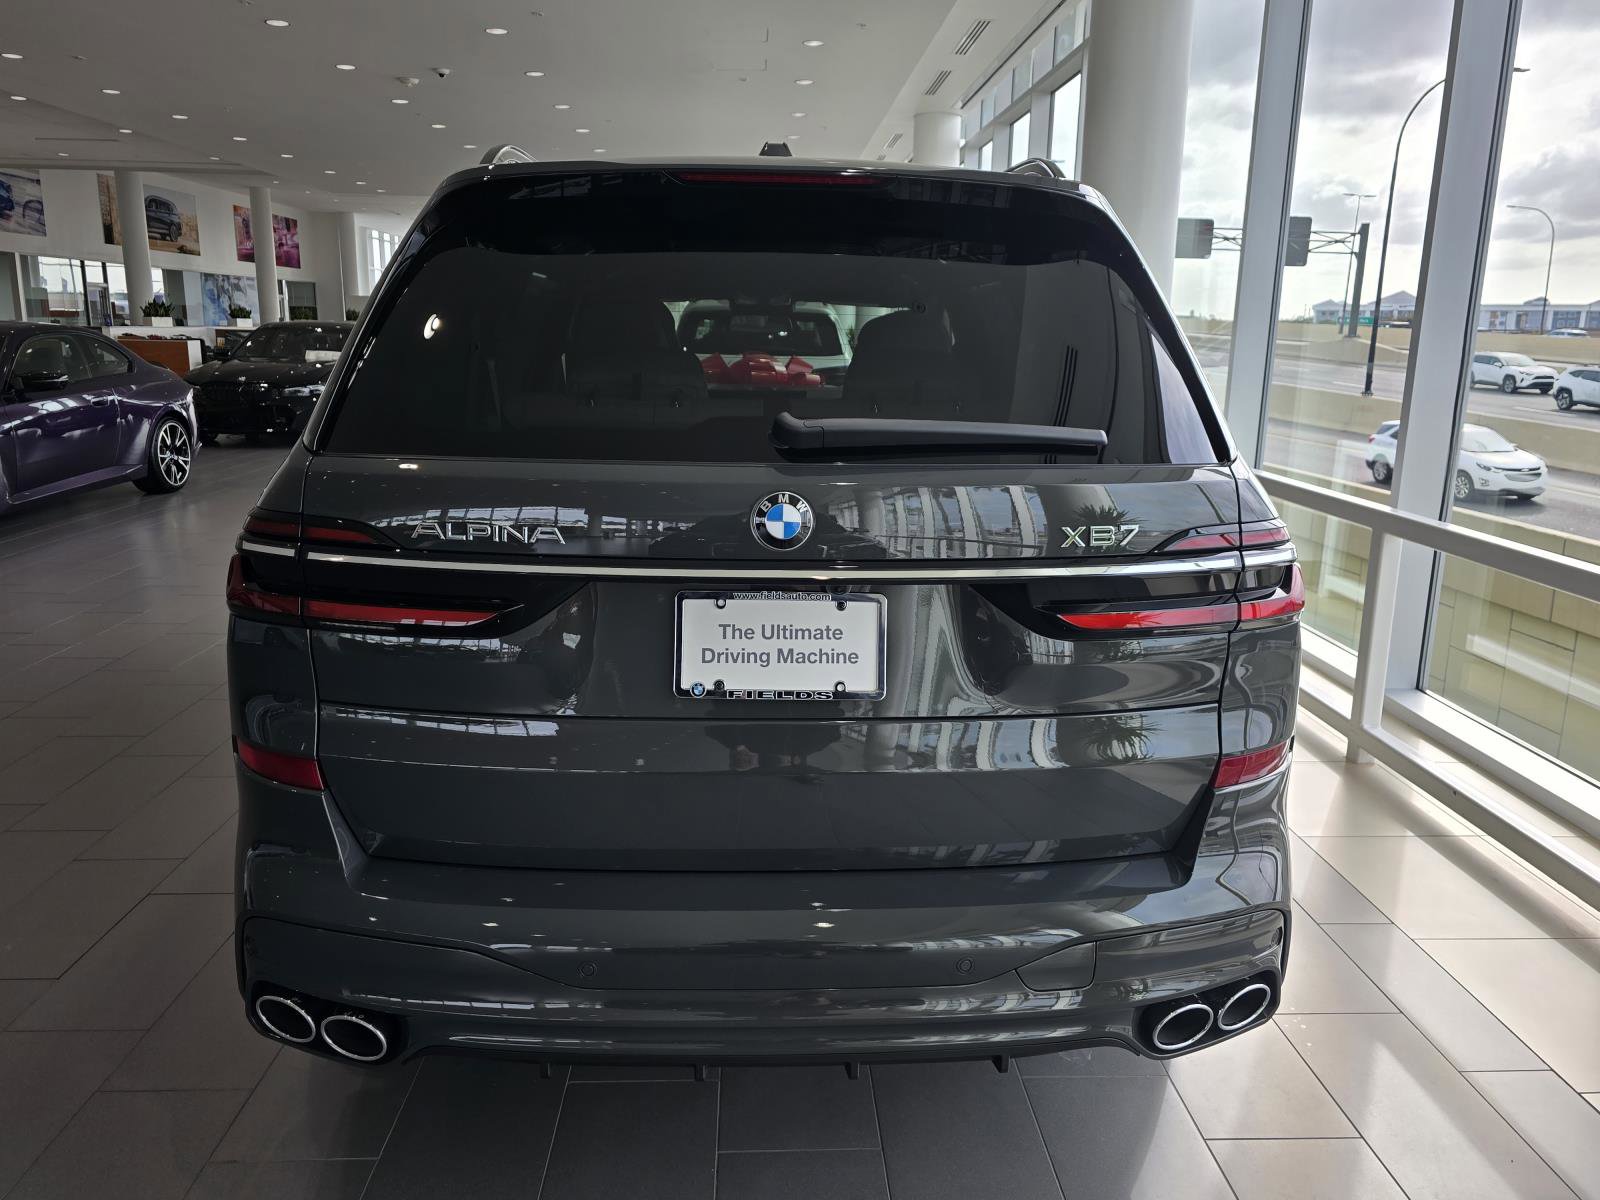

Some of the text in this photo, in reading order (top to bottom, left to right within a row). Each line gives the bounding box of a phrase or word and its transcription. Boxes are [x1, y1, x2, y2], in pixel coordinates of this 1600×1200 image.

[759, 493, 808, 513] BMW
[411, 522, 566, 545] ALPINA
[1060, 524, 1140, 548] XB7
[732, 590, 832, 601] www.fieldsauto.com
[718, 623, 844, 641] The Ultimate
[701, 647, 859, 668] Driving Machine
[726, 689, 833, 700] FIELDS
